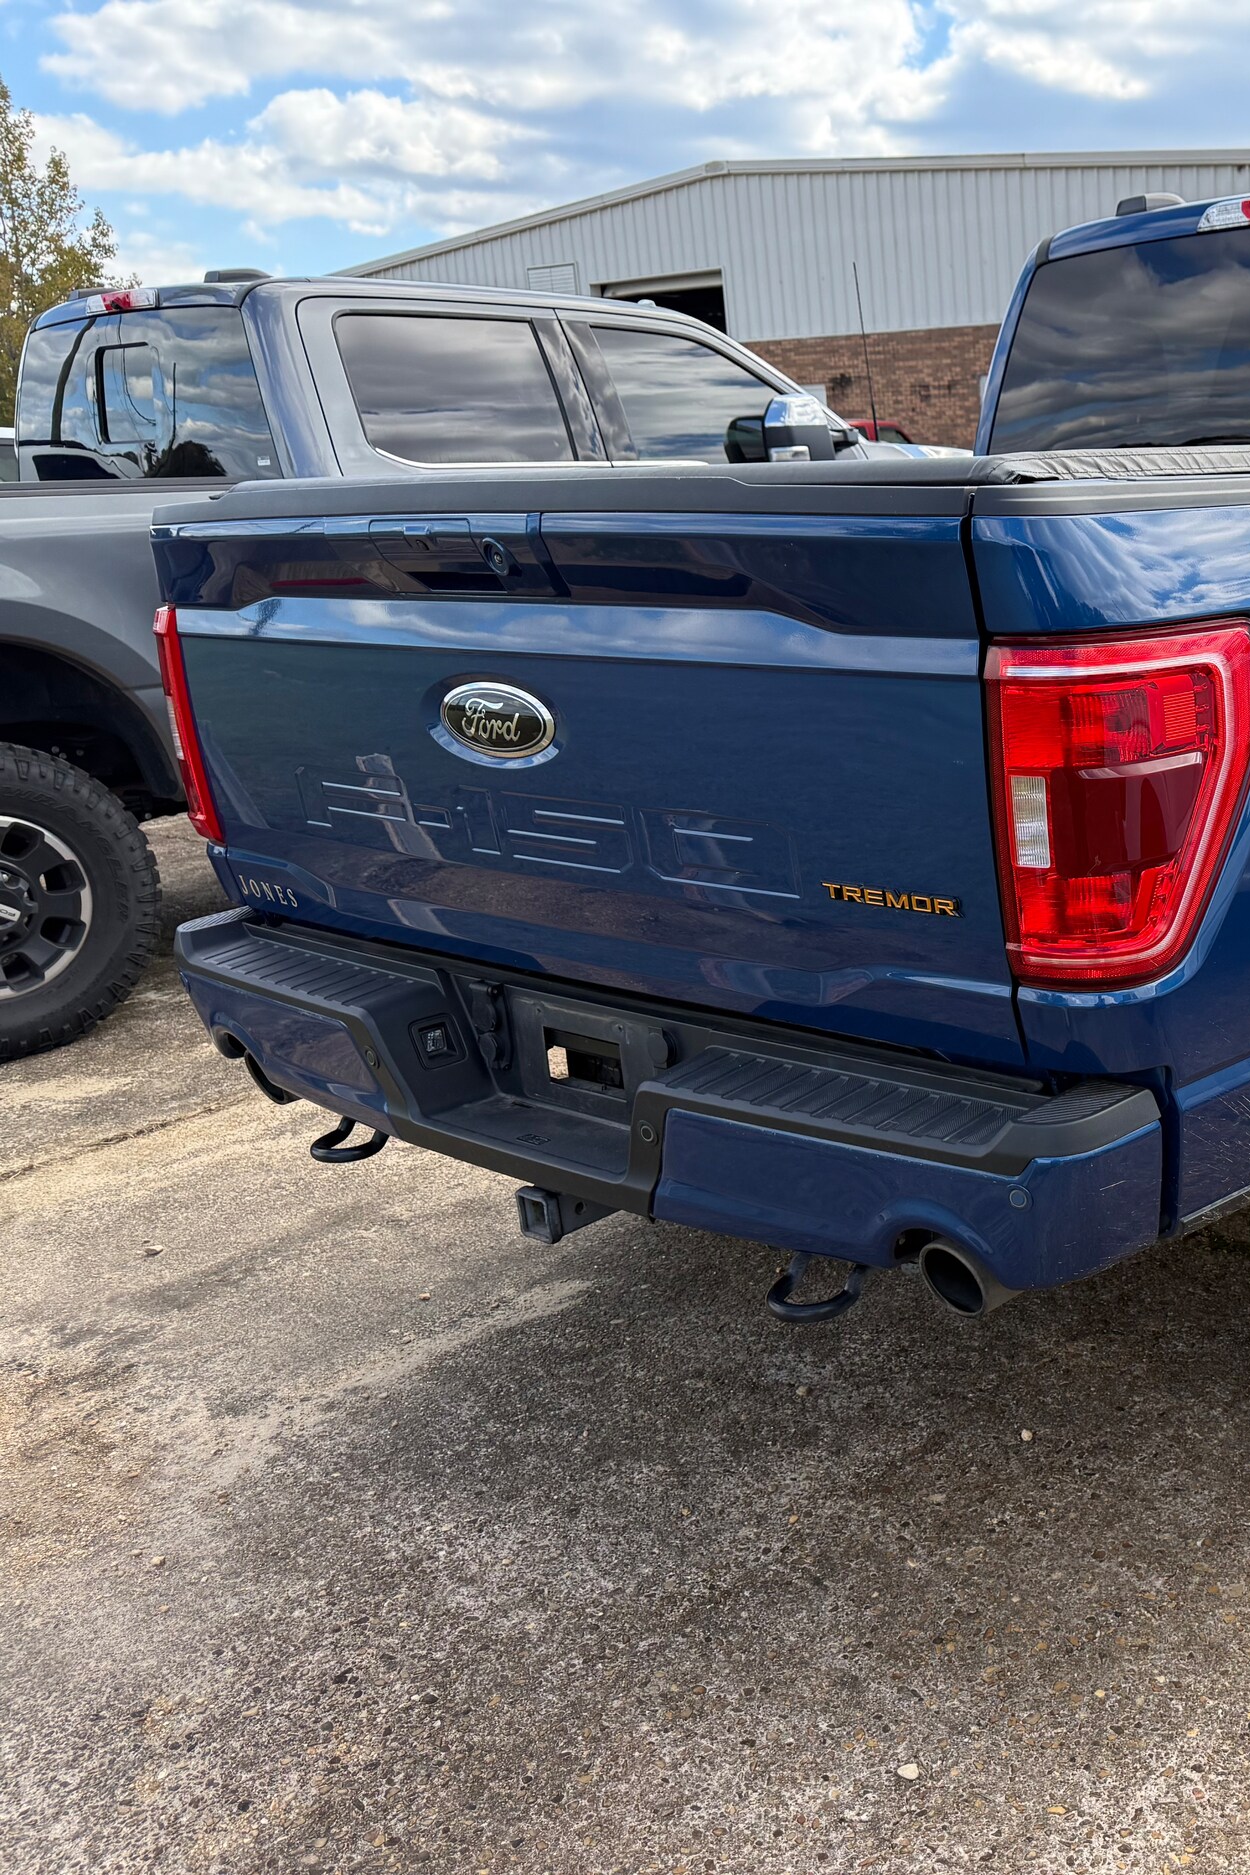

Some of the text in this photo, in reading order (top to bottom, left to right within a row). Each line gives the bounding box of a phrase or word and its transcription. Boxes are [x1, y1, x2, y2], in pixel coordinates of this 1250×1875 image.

[461, 697, 521, 742] Ford
[238, 874, 298, 908] JONES
[821, 882, 961, 918] TREMOR
